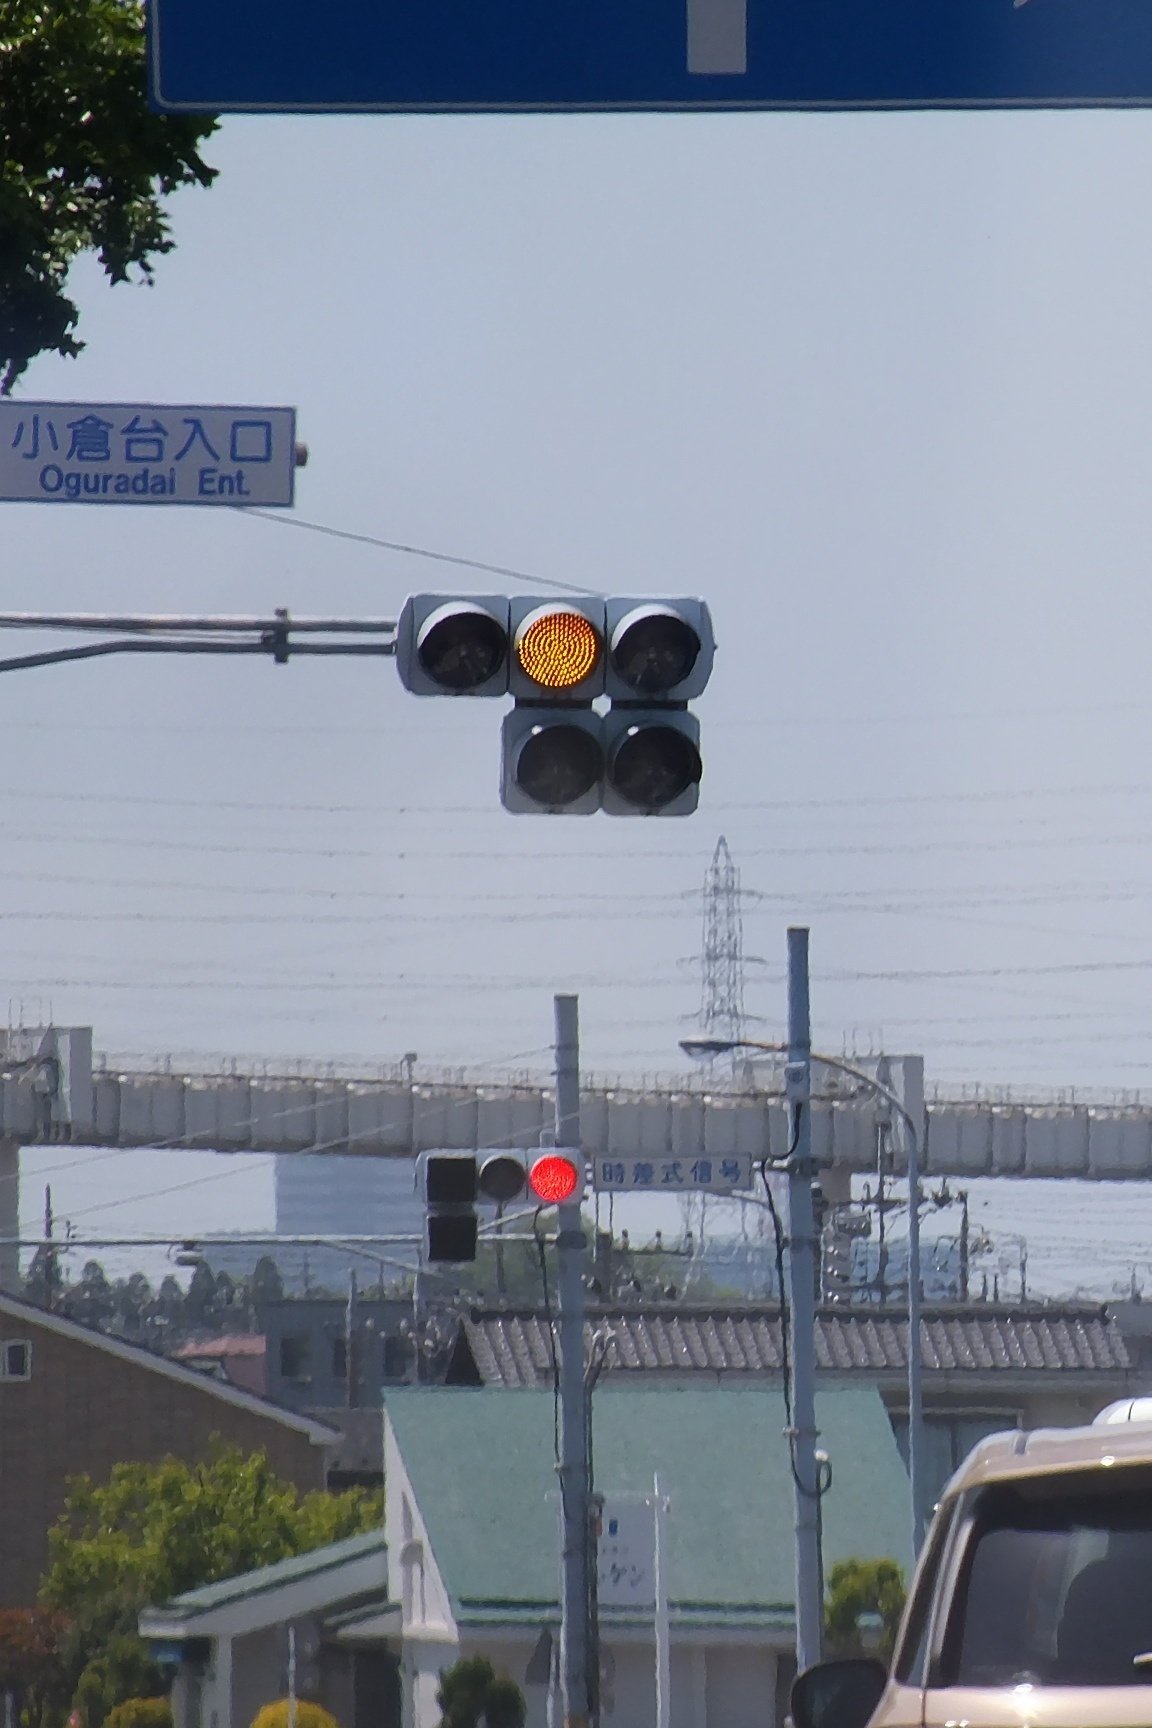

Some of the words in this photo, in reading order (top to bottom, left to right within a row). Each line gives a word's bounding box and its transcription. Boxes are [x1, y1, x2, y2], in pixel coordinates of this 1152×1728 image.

[11, 413, 272, 463] 小倉台入口
[39, 464, 176, 498] Oguradai
